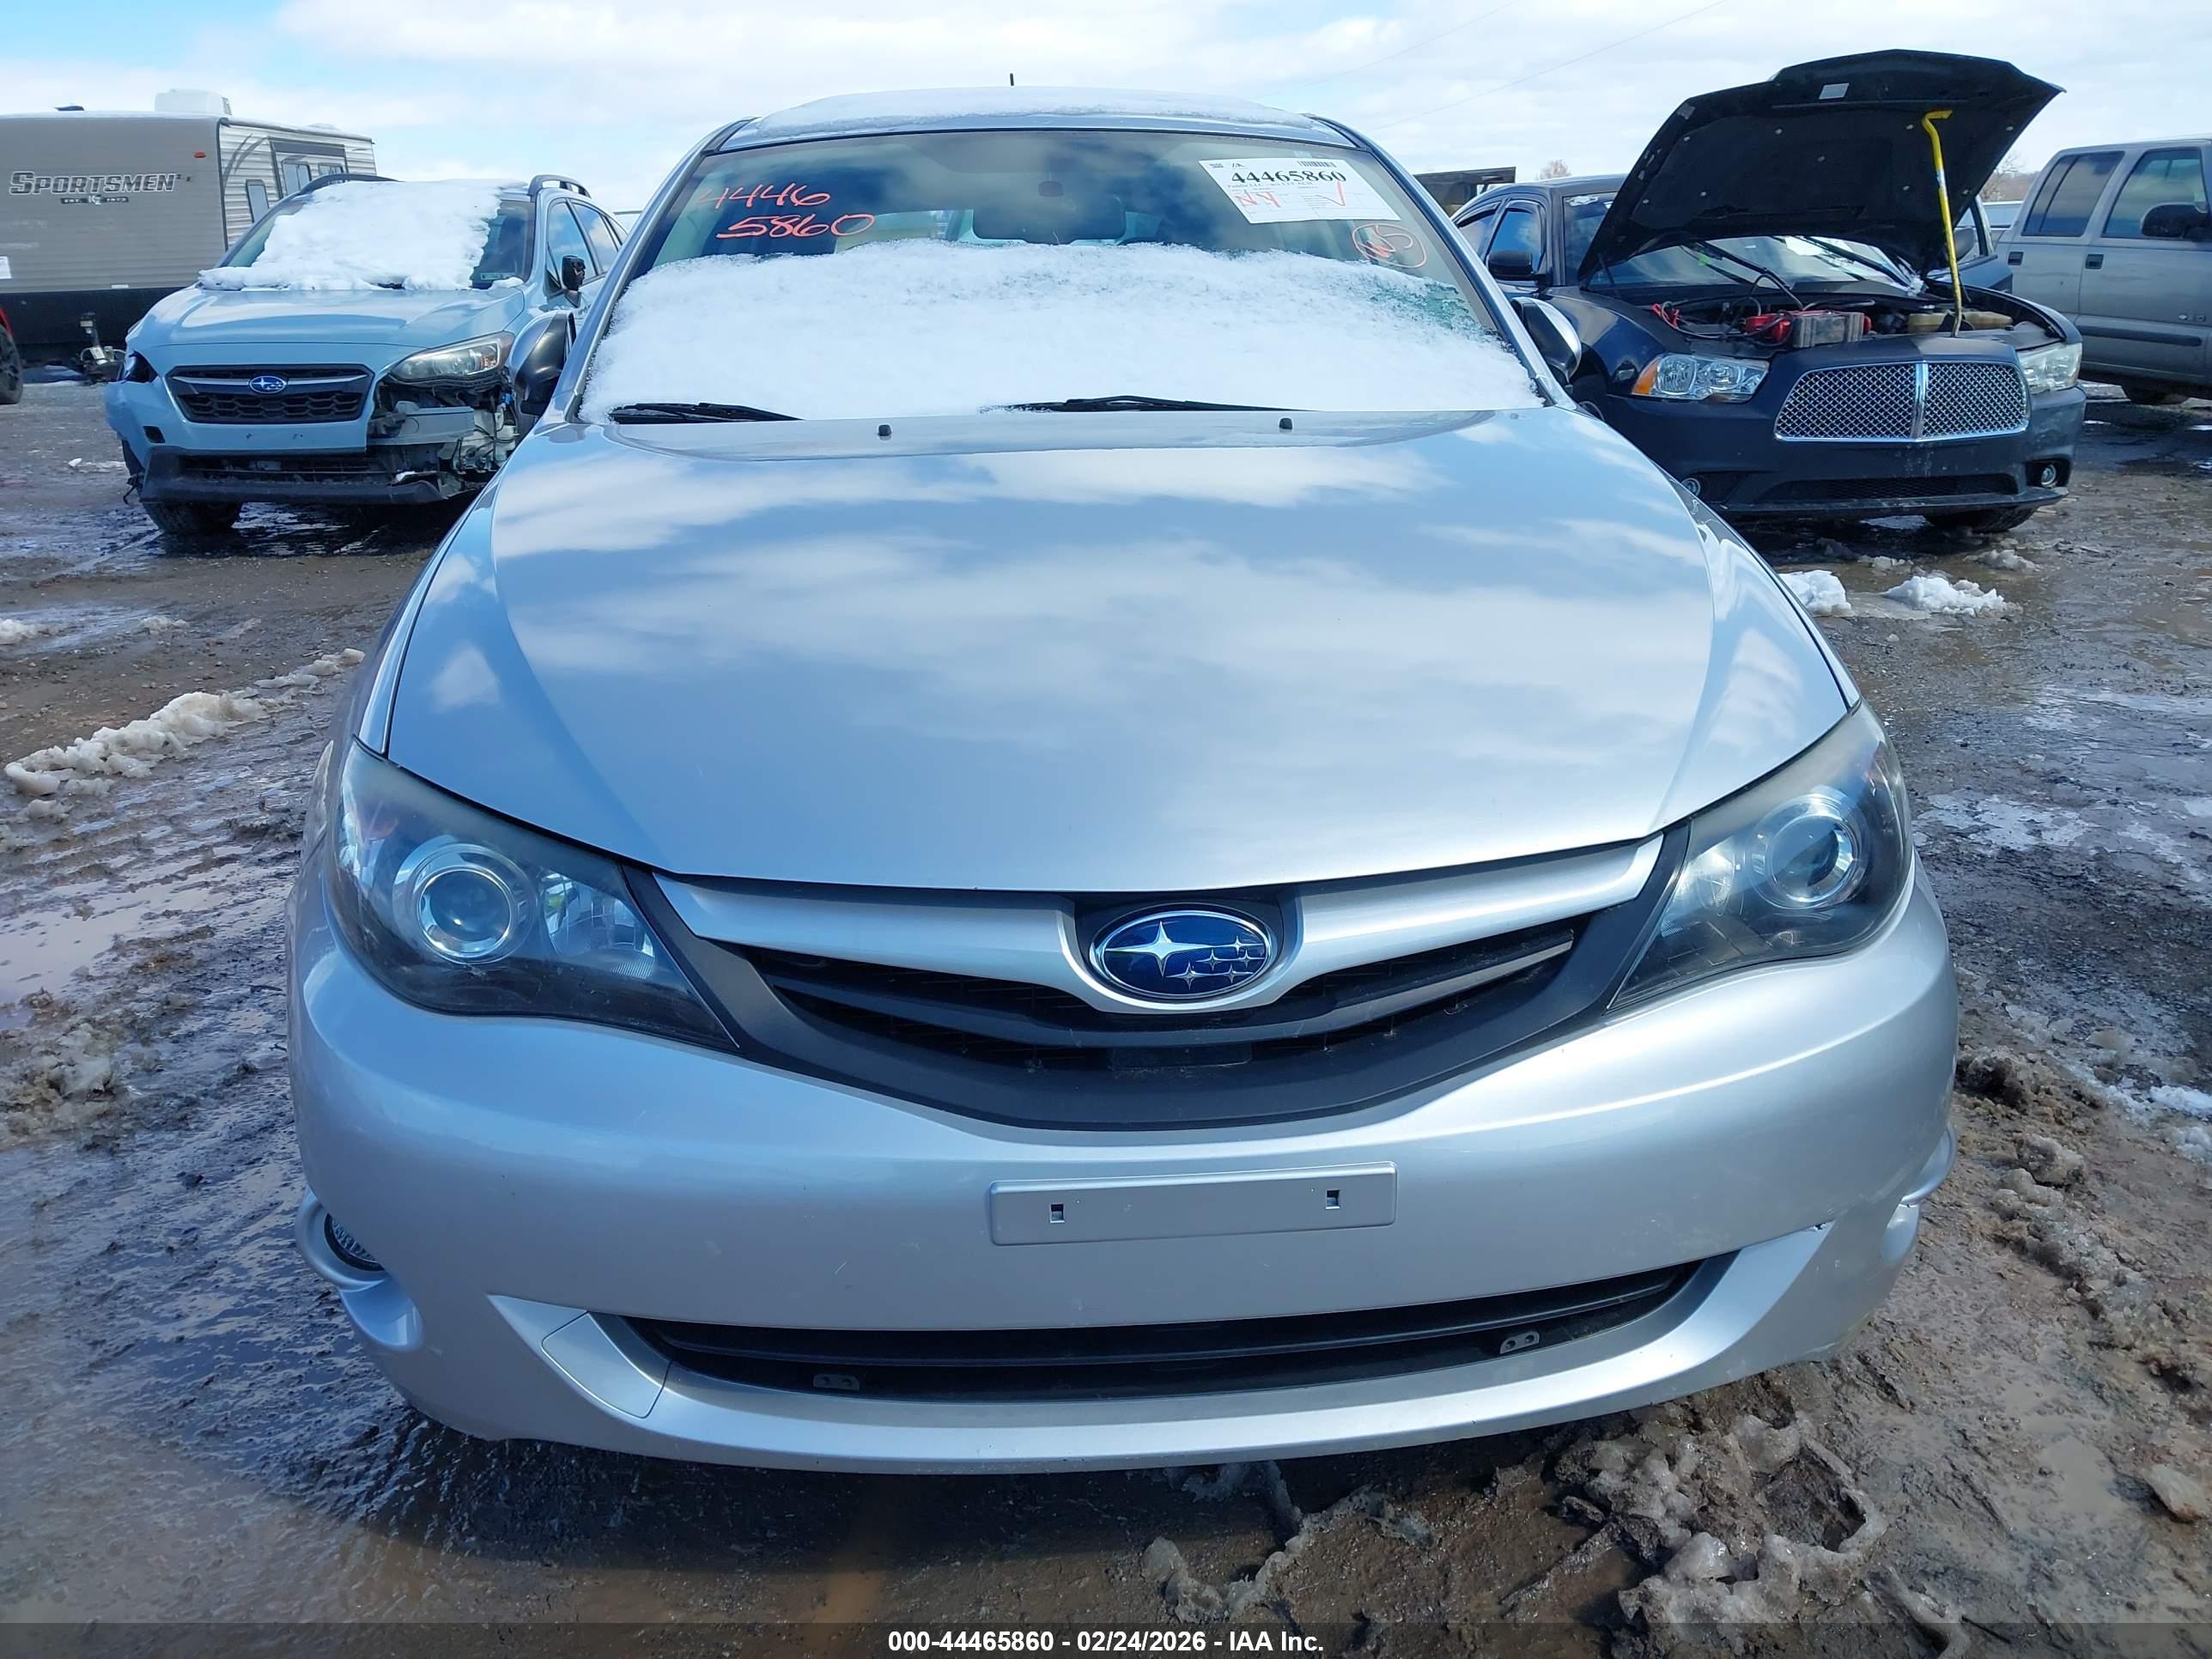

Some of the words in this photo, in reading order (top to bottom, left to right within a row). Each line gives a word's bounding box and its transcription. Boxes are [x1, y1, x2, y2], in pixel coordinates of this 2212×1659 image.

[9, 171, 176, 196] SPORTSMEN
[1231, 170, 1346, 183] 44465860
[696, 183, 831, 209] 4446
[716, 213, 876, 238] 5860
